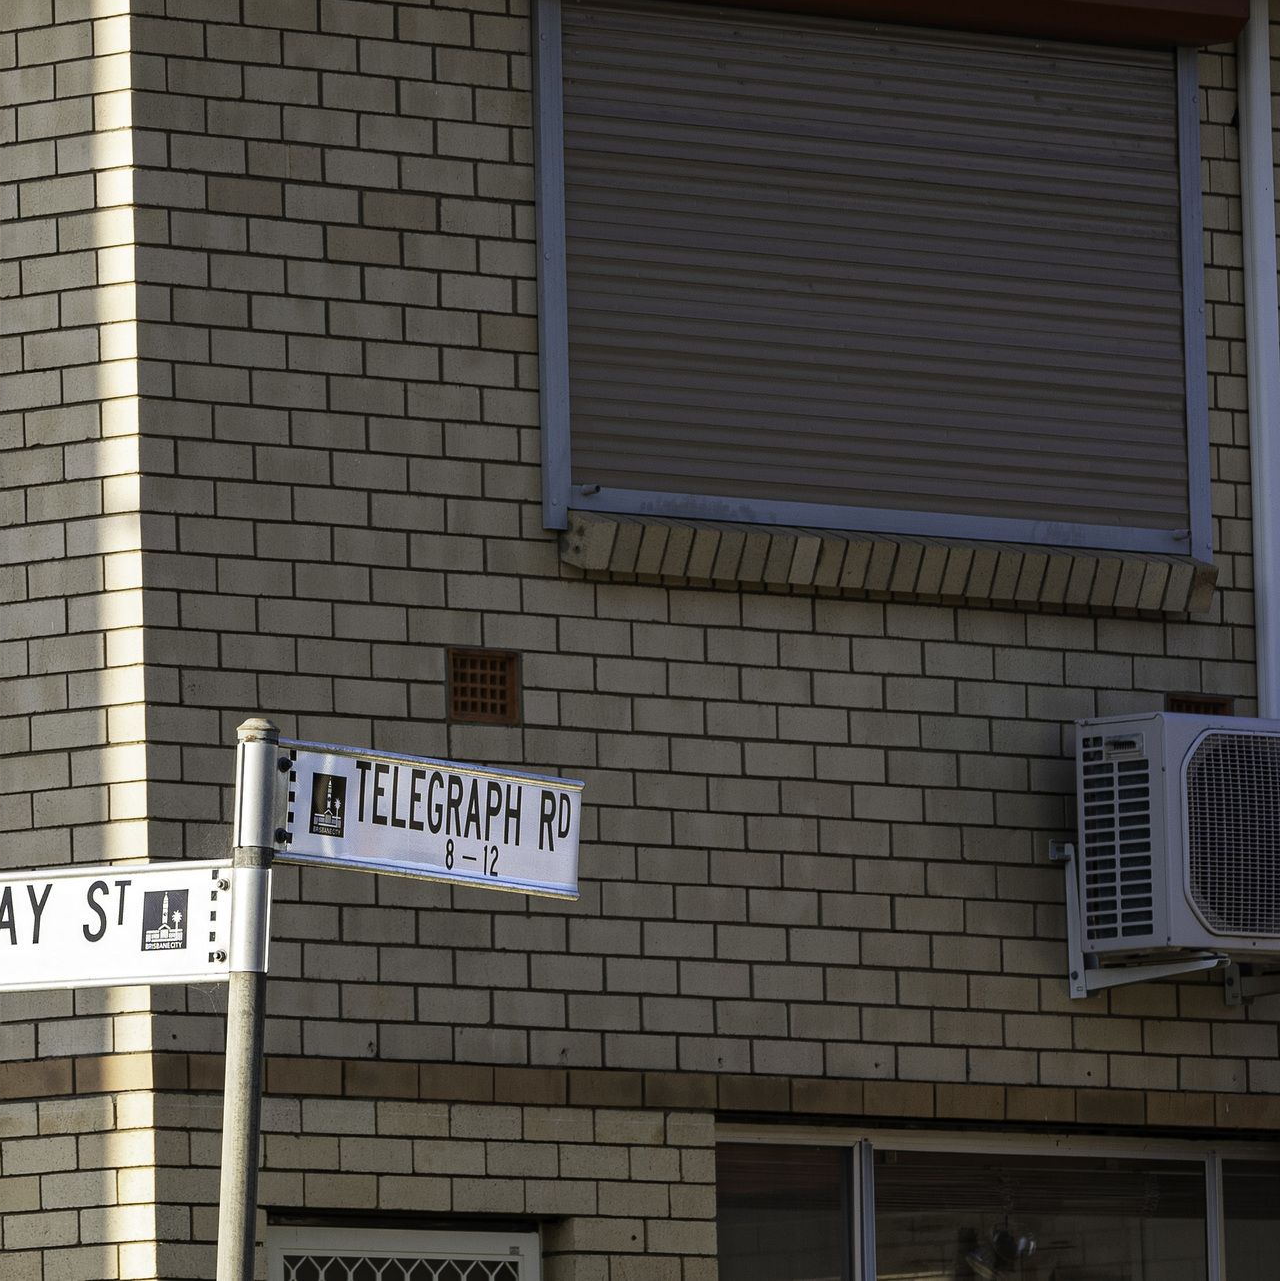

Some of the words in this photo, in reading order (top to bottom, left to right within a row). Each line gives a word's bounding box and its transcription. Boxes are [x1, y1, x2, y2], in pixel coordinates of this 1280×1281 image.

[355, 759, 523, 847] TELEGRAPH
[538, 789, 571, 852] RD
[445, 838, 455, 871] 8
[483, 844, 499, 878] 12
[82, 880, 132, 943] ST
